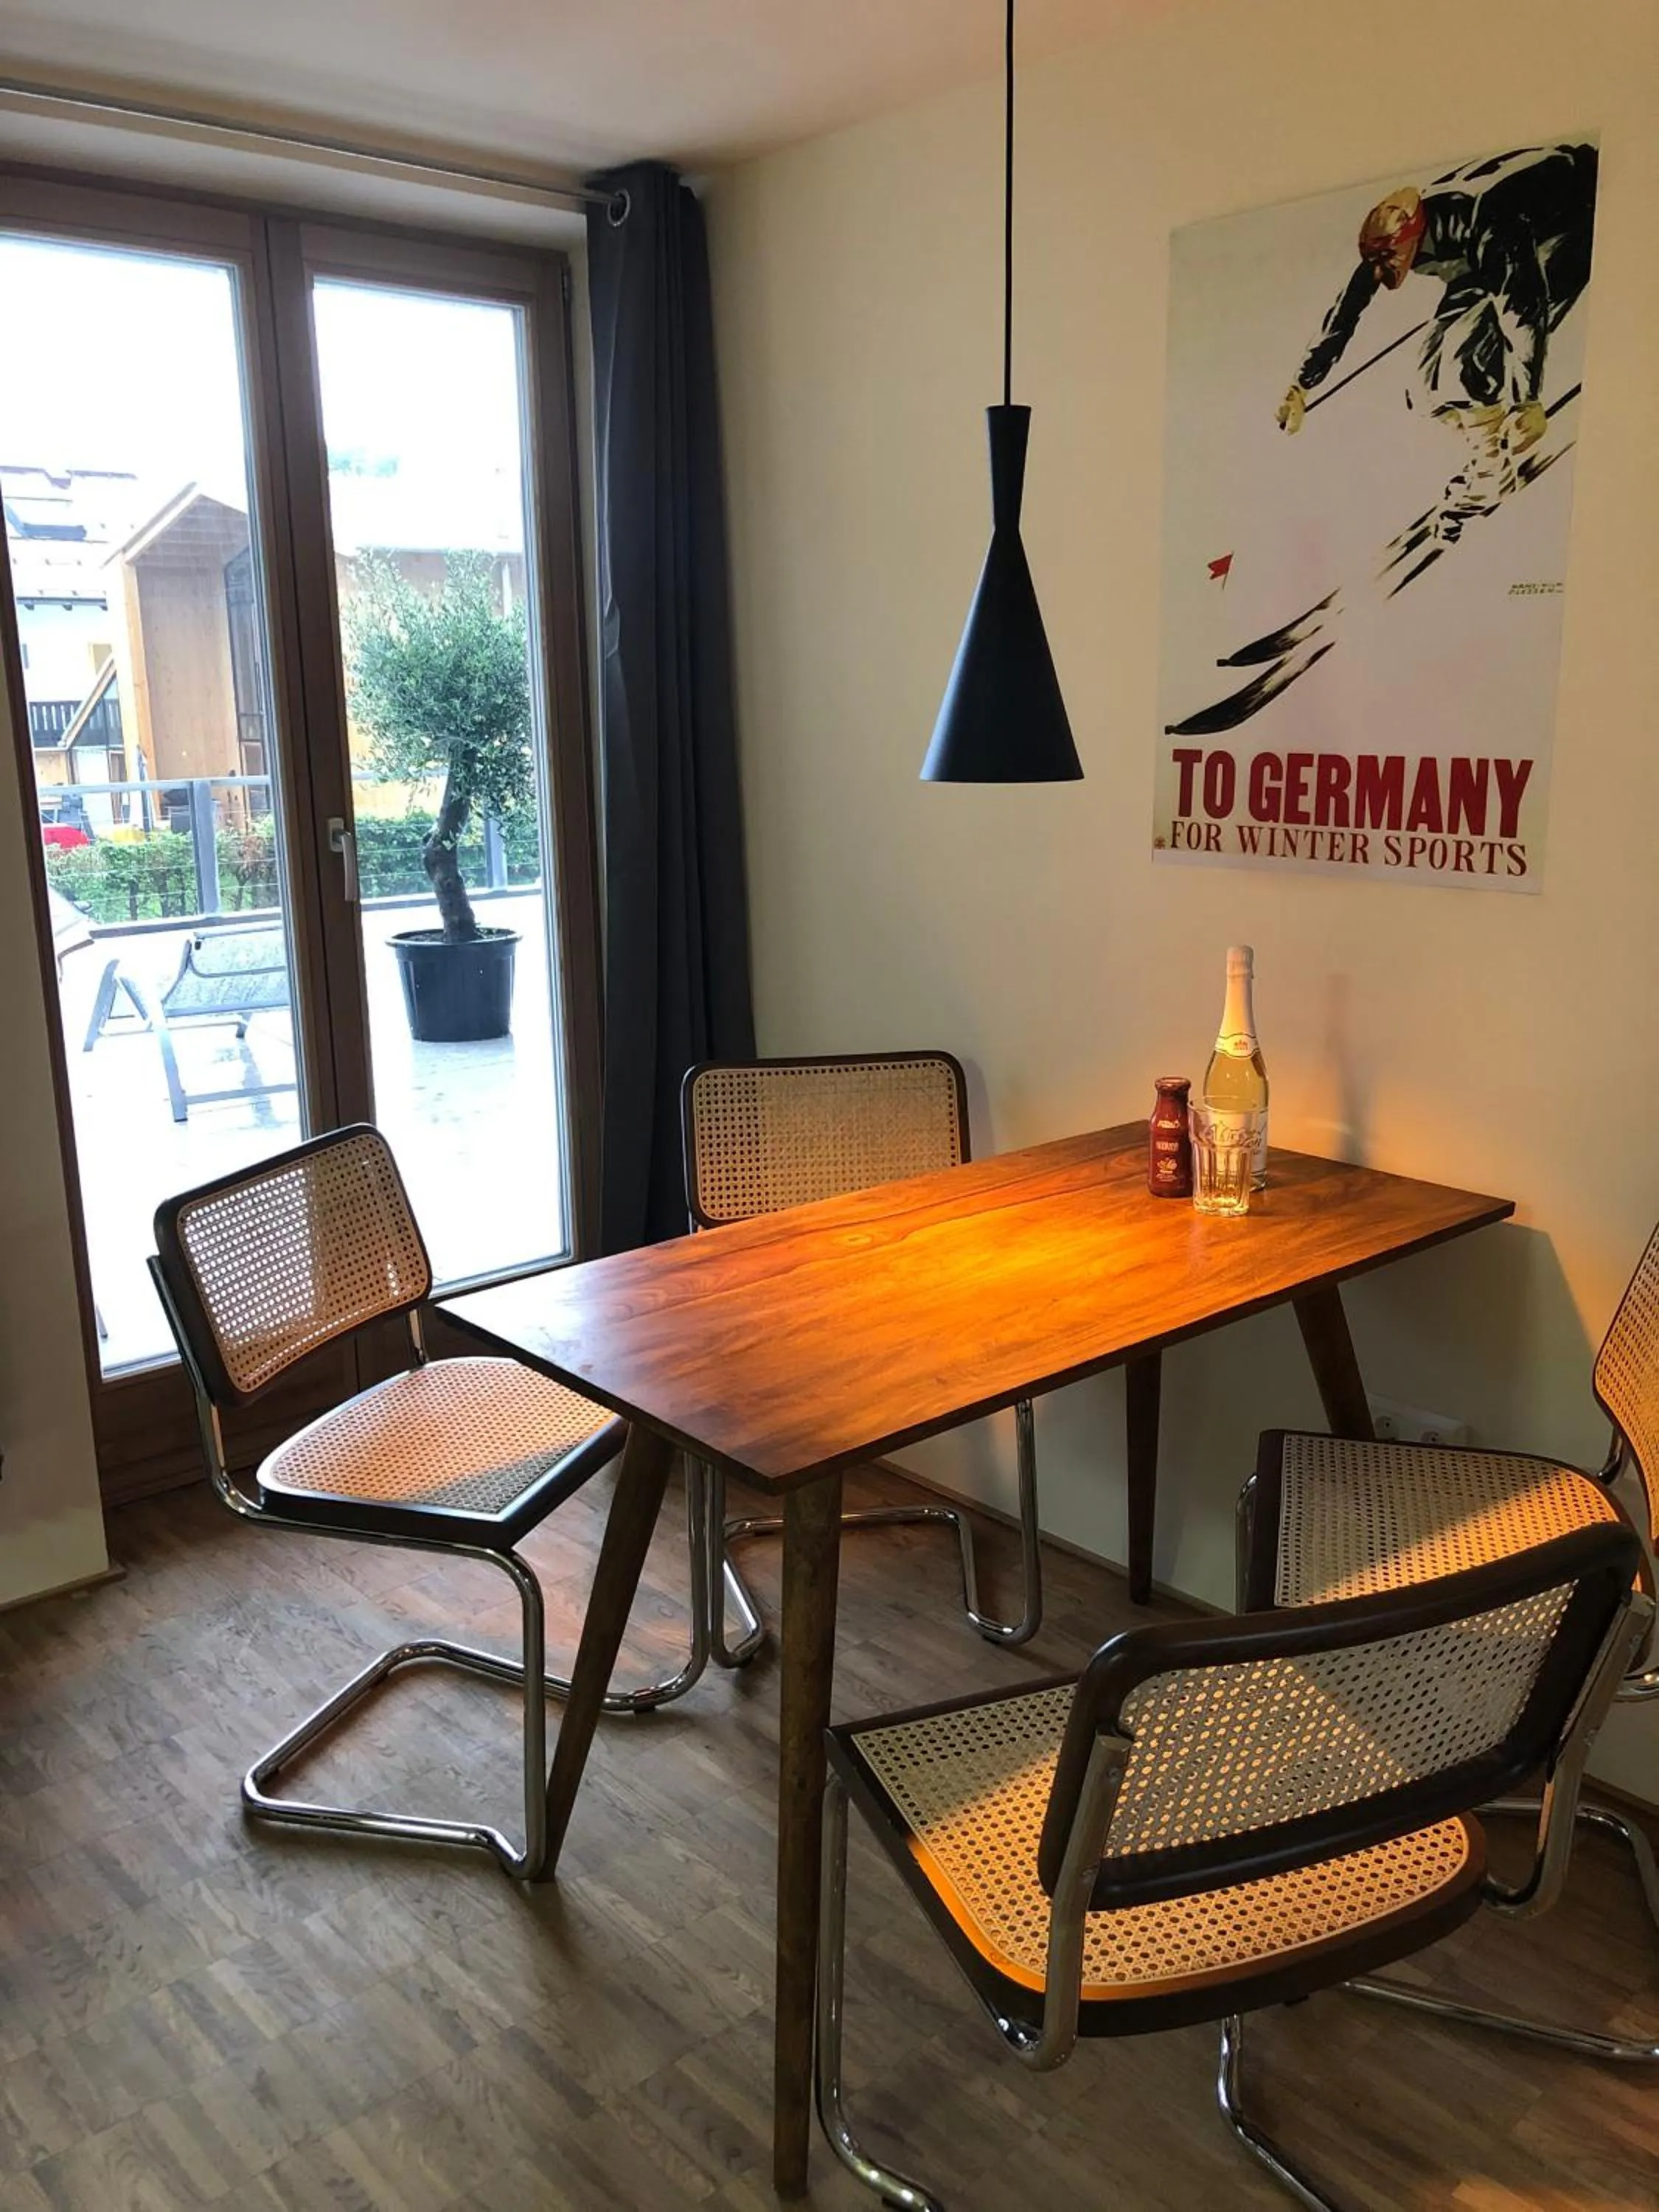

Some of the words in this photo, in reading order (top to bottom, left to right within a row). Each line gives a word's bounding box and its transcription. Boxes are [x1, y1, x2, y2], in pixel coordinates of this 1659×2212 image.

[1172, 748, 1237, 820] TO
[1248, 751, 1534, 839] GERMANY
[1170, 820, 1223, 853] FOR
[1236, 824, 1370, 865] WINTER
[1384, 835, 1528, 877] SPORTS
